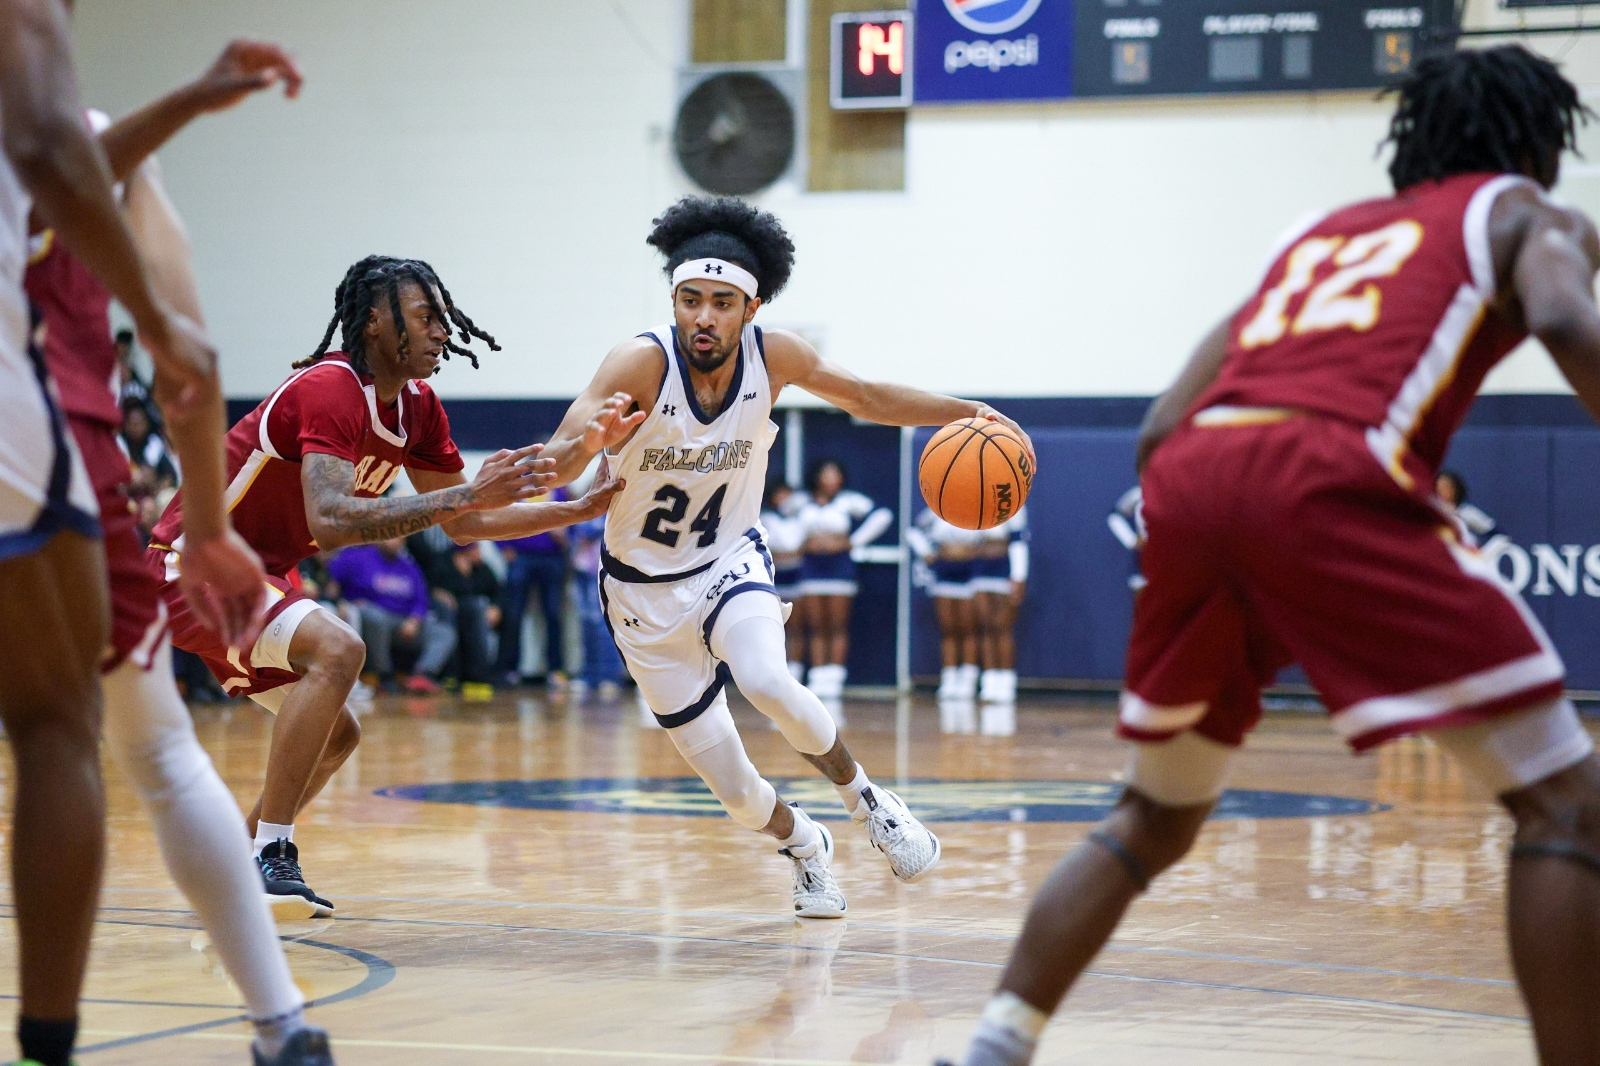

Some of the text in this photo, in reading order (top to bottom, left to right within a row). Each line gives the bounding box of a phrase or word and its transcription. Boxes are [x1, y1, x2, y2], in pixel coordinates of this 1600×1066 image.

[858, 21, 904, 76] 14
[944, 33, 1039, 74] pepsi
[1238, 216, 1425, 350] 12
[638, 438, 753, 475] FALCONS
[640, 481, 730, 549] 24
